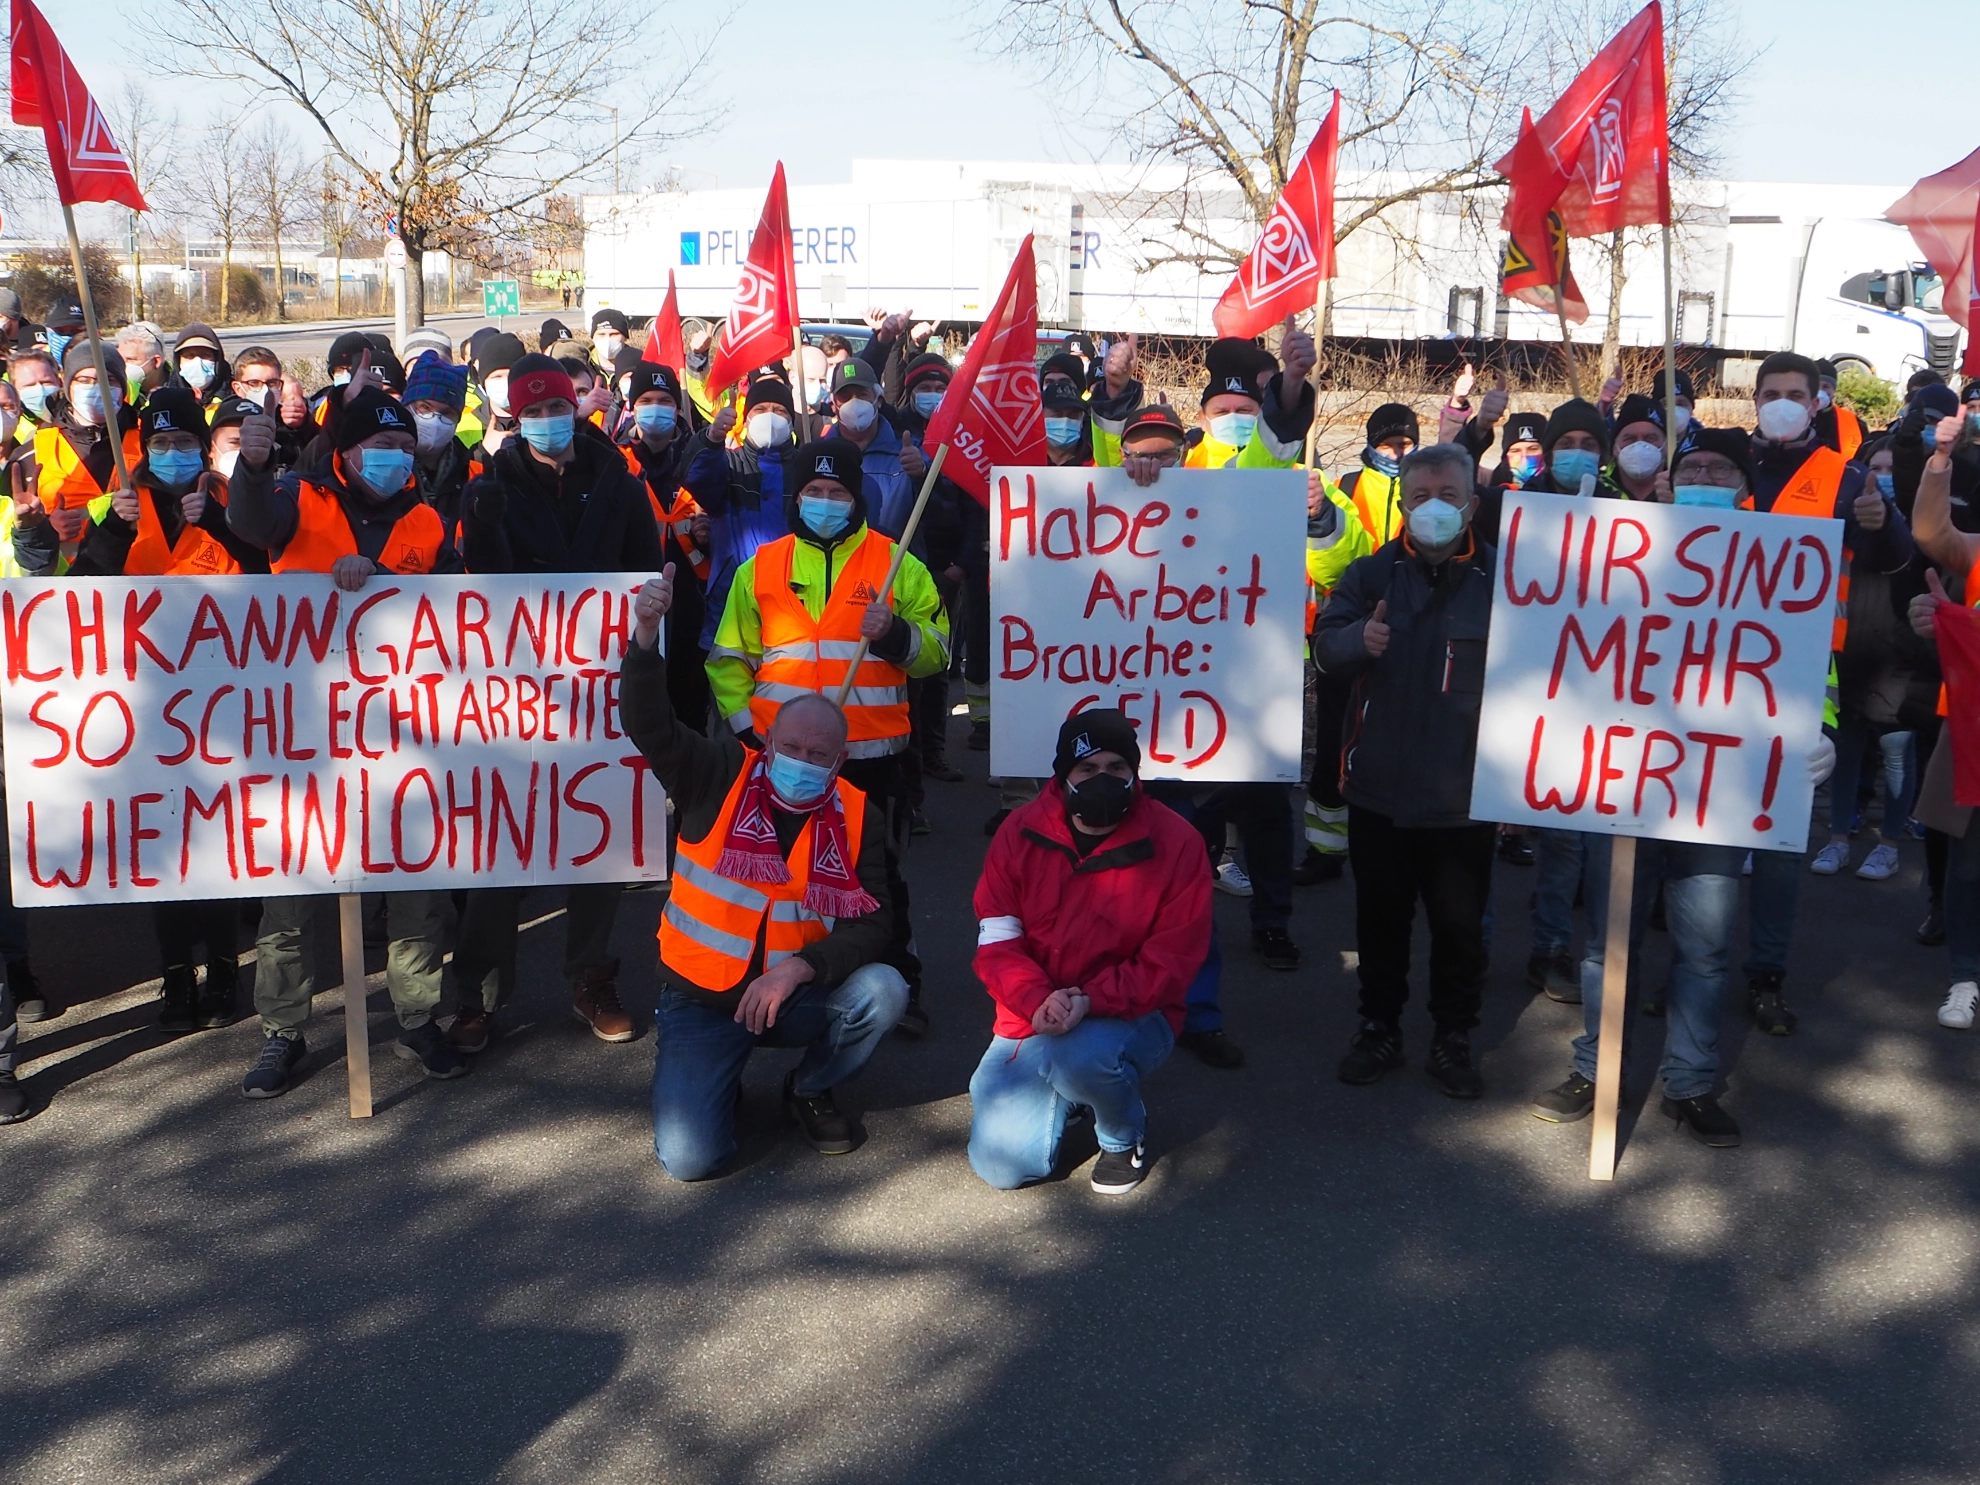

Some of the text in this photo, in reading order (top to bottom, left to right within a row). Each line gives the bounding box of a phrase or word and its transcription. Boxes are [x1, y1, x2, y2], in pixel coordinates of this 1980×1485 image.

[998, 473, 1199, 562] Habe:
[1503, 506, 1833, 614] WIR SIND
[2, 586, 644, 687] ICH KANN GAR NICH
[1083, 553, 1268, 627] Arbeit
[998, 614, 1213, 685] Brauche:
[1546, 612, 1782, 718] MEHR
[28, 668, 630, 769] SO SCHLECHT ARBEITE
[26, 755, 652, 890] WIE MEIN LOHN IST
[1523, 714, 1784, 833] WERT!
